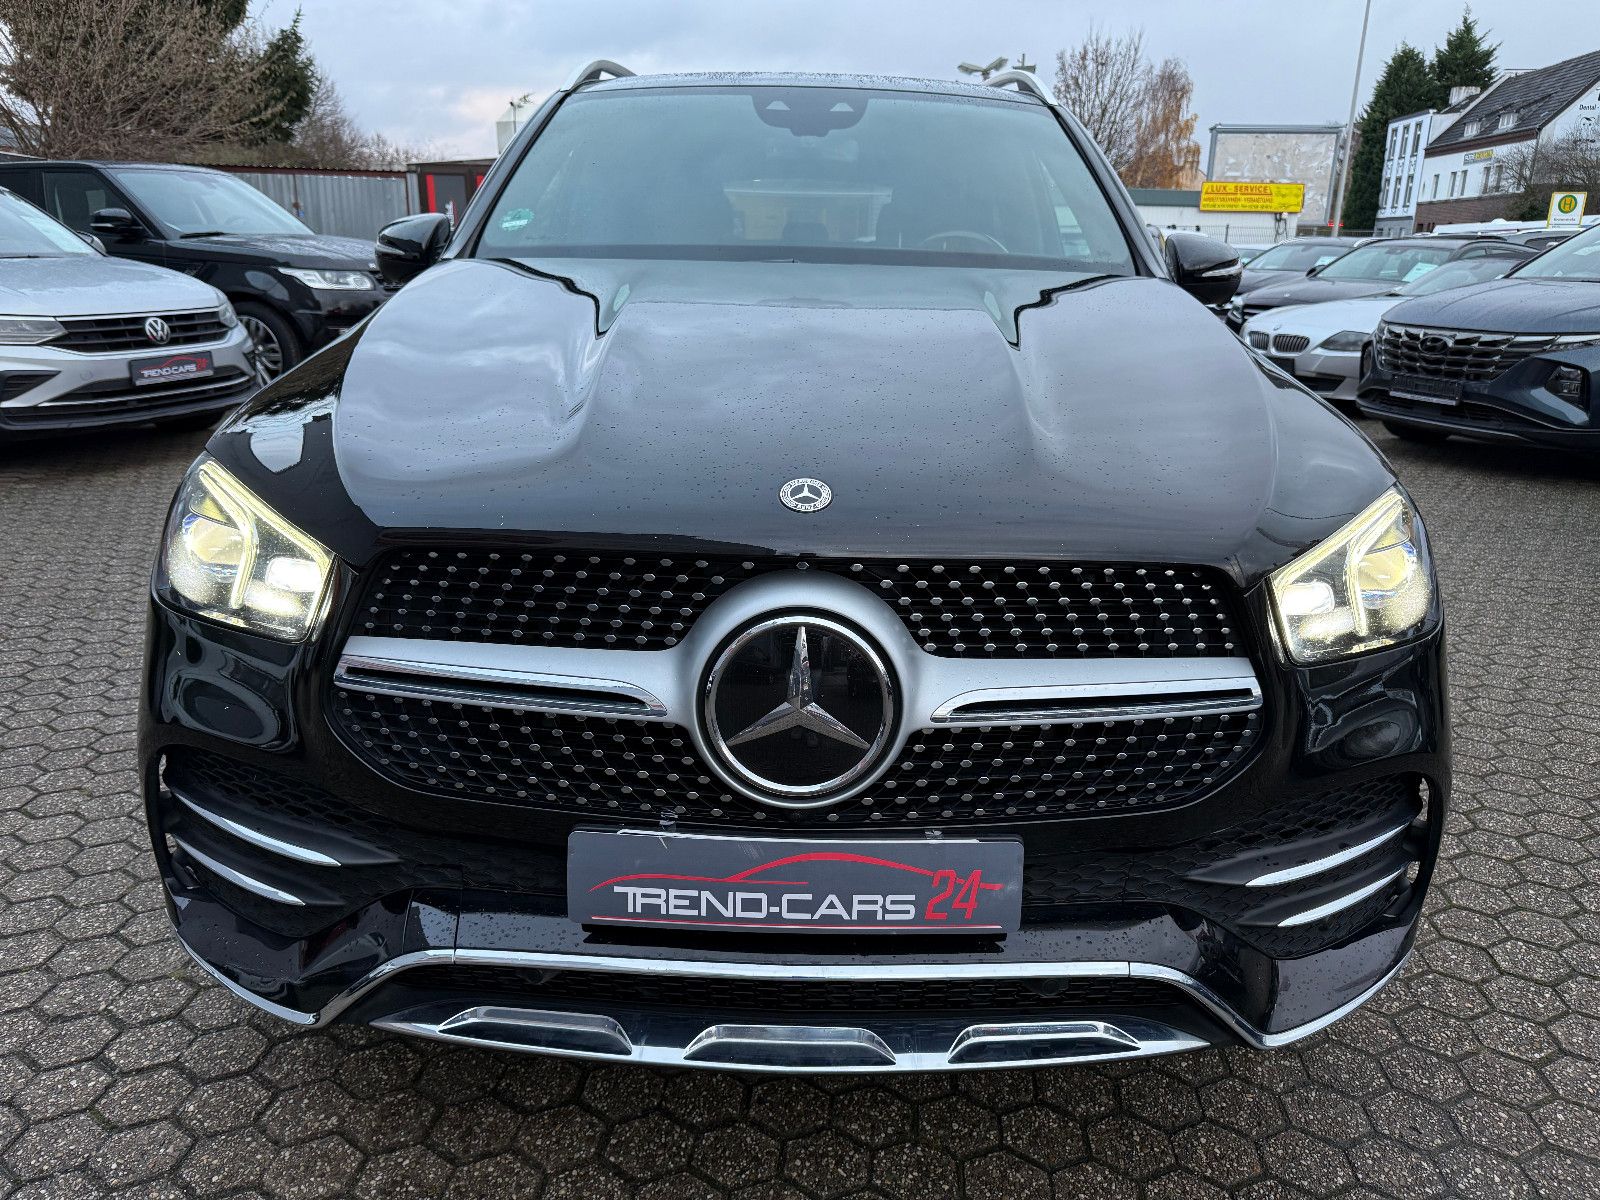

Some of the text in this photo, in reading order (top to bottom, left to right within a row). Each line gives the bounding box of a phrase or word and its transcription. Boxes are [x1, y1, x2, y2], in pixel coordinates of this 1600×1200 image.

[1210, 184, 1228, 193] LUX
[1233, 184, 1269, 194] SERVICE
[613, 869, 982, 921] TREND-CARS 24
